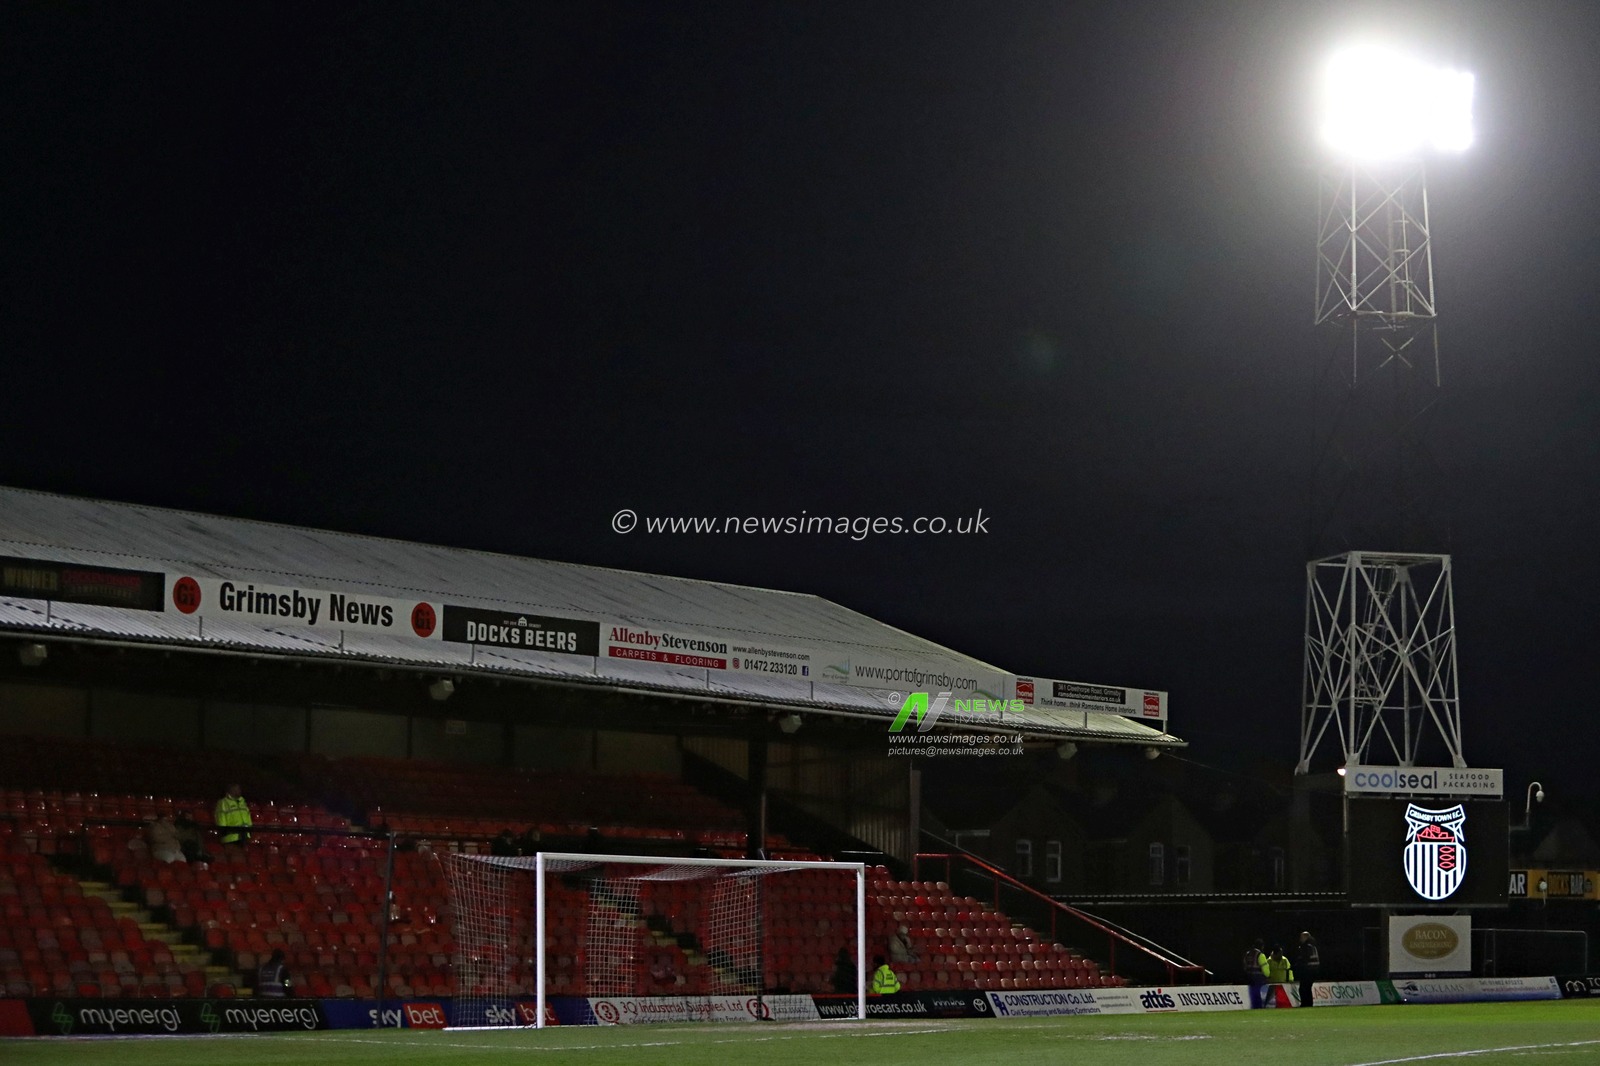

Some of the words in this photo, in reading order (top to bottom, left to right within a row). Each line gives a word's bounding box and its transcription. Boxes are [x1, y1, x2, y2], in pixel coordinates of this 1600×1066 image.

[219, 582, 321, 626] Grimsby
[329, 594, 393, 627] News
[467, 620, 520, 645] DOCKS
[525, 631, 577, 651] BEERS
[616, 648, 656, 662] CARPETS
[663, 653, 669, 663] &
[675, 654, 719, 668] FLOORING
[732, 645, 811, 662] www.allenbystevenson.com
[744, 658, 768, 672] 01472
[770, 662, 797, 675] 233120
[855, 665, 978, 690] www.portofgrimsby.com
[1355, 769, 1437, 790] coolseal
[1443, 781, 1496, 789] PACKAGING
[1449, 773, 1490, 781] SEAFOOD
[1415, 930, 1447, 940] BACON
[638, 1001, 685, 1013] Industrial
[686, 1000, 726, 1016] Supplies
[727, 999, 743, 1013] Ltd
[1005, 993, 1067, 1007] CONSTRUCTION
[1140, 988, 1175, 1009] attis
[1177, 992, 1243, 1006] INSURANCE
[80, 1005, 182, 1032] myenergi
[225, 1003, 319, 1030] myenergi
[407, 1005, 443, 1025] bet
[1022, 1008, 1048, 1017] Engineering
[1058, 1007, 1076, 1016] Building
